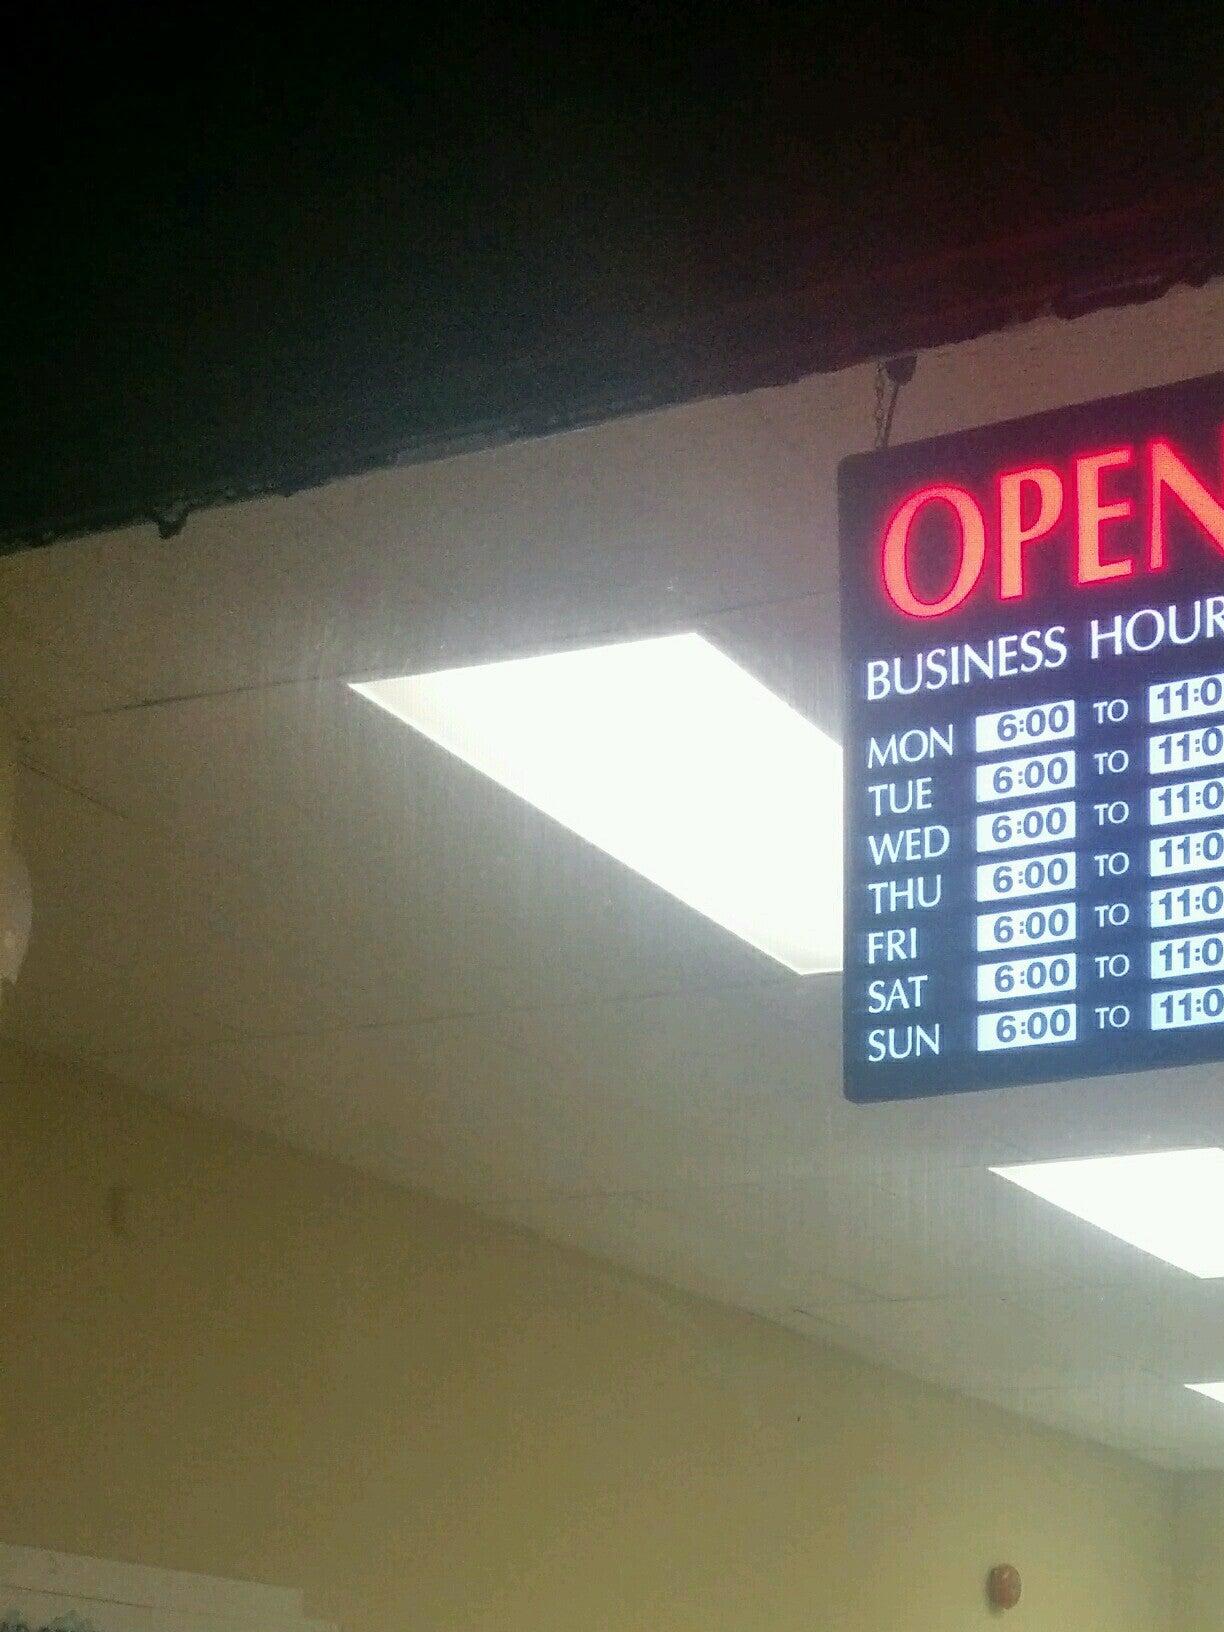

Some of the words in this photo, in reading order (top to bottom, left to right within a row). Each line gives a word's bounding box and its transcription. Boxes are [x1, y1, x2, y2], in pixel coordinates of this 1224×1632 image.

[866, 626, 1067, 700] BUSINESS
[866, 724, 954, 769] MON
[996, 706, 1069, 742] 6:00
[1093, 699, 1129, 724] TO
[869, 778, 933, 818] TUE
[992, 756, 1068, 794] 6:00
[1093, 750, 1129, 775] TO
[868, 825, 951, 867] WED
[990, 807, 1067, 844] 6:00
[1093, 801, 1130, 826] TO
[868, 875, 942, 915] THU
[991, 858, 1068, 893] 6:00
[1094, 852, 1130, 877] TO
[868, 928, 918, 965] FRI
[992, 908, 1069, 944] 6:00
[1094, 903, 1130, 928] TO
[868, 975, 929, 1016] SAT
[993, 959, 1070, 995] 6:00
[1094, 955, 1130, 979] TO
[866, 1023, 941, 1063] SUN
[995, 1008, 1071, 1044] 6:00
[1094, 1006, 1130, 1031] TO
